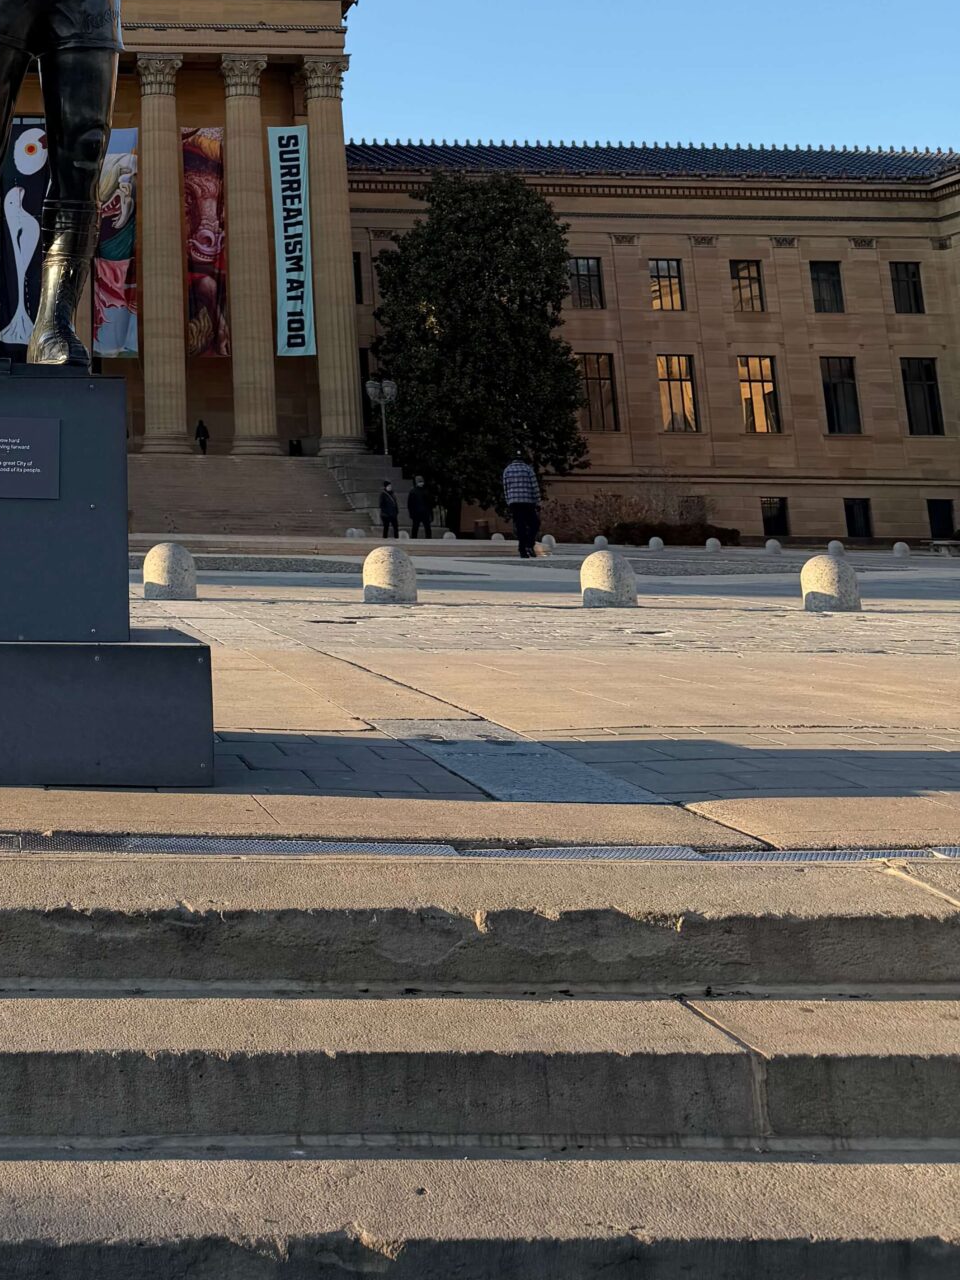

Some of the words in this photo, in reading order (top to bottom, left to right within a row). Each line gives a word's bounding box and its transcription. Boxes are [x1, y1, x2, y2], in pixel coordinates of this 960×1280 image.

[278, 134, 304, 274] SURREALISM
[286, 278, 305, 306] AT
[286, 309, 306, 348] 100
